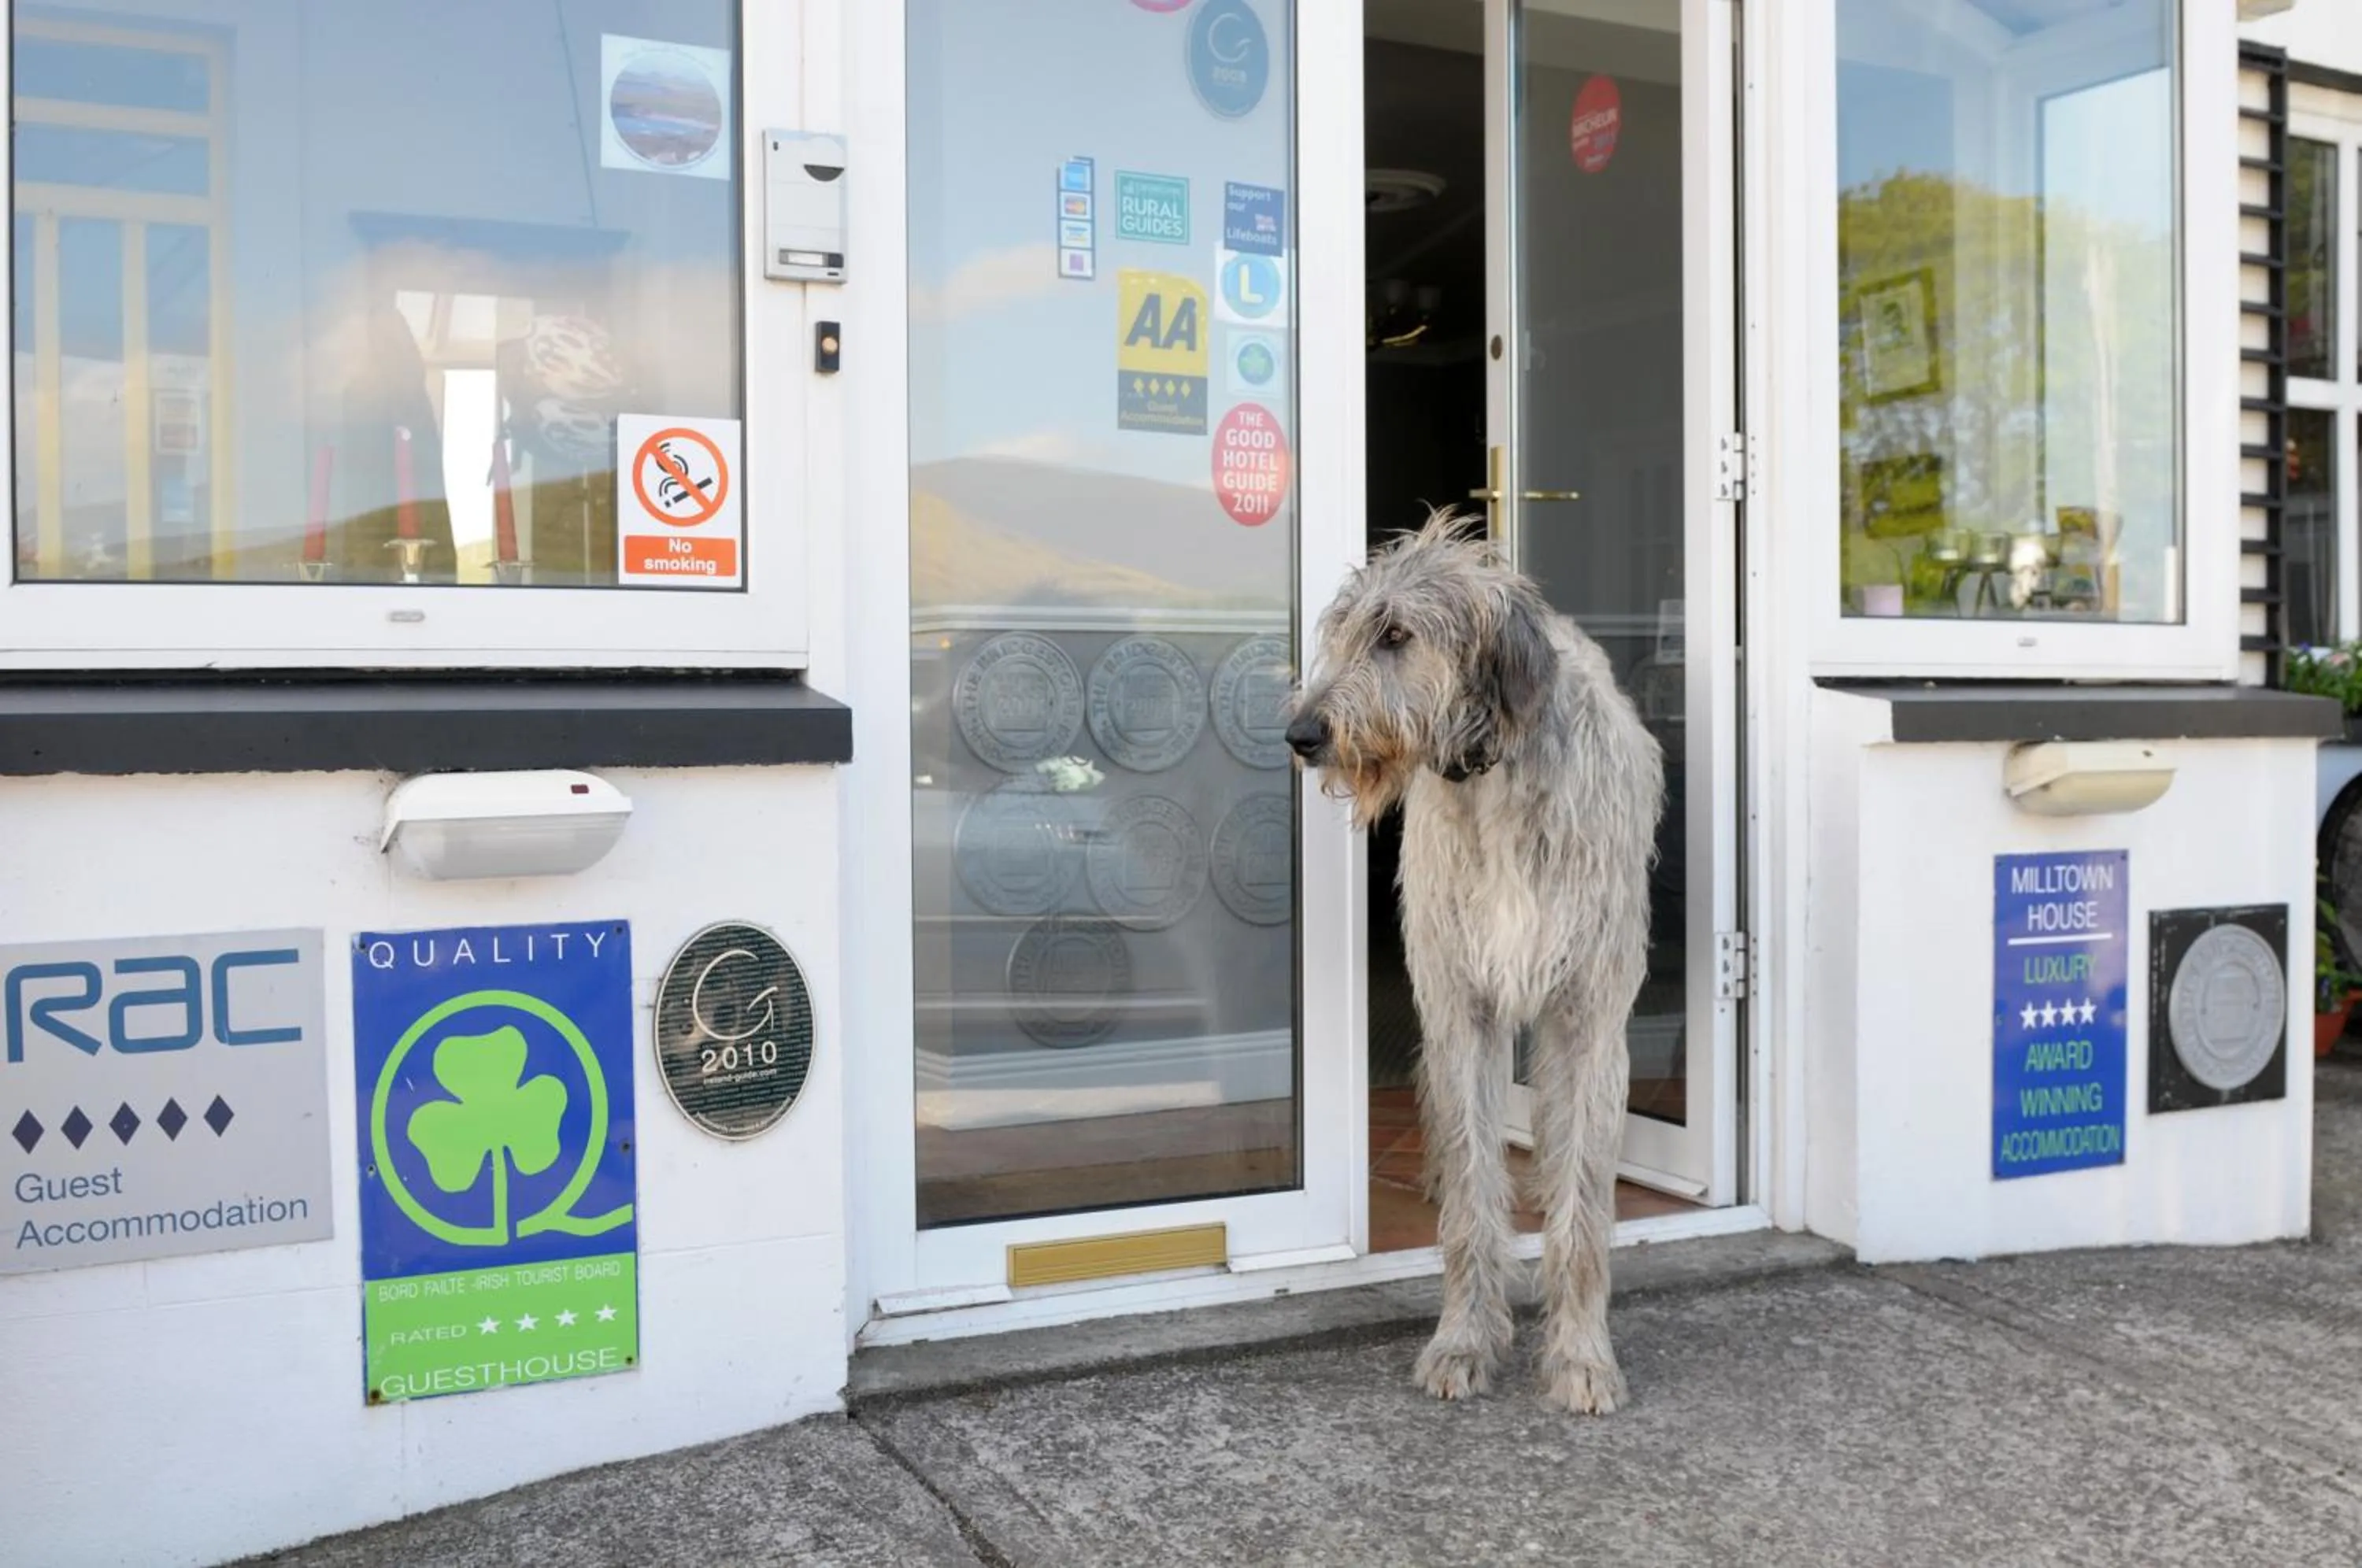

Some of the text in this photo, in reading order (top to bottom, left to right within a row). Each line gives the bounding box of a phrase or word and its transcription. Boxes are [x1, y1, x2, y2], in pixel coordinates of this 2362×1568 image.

[1228, 184, 1272, 202] Support
[1122, 196, 1183, 219] RURAL
[1227, 202, 1246, 213] our
[1122, 215, 1183, 236] GUIDES
[1227, 227, 1277, 246] Lifeboats
[1240, 264, 1264, 304] L
[1124, 293, 1197, 352] AA
[1238, 411, 1264, 427] THE
[1225, 429, 1275, 449] GOOD
[1223, 449, 1279, 471] HOTEL
[1222, 471, 1278, 492] GUIDE
[1233, 494, 1269, 514] 2011
[669, 538, 692, 554] No
[643, 555, 716, 575] smoking
[2012, 864, 2113, 893] MILLTOWN
[2028, 901, 2098, 931] HOUSE
[369, 931, 605, 969] QUALITY
[2024, 955, 2096, 984] LUXURY
[702, 1041, 777, 1073] 2010
[2025, 1041, 2093, 1071] AWARD
[2020, 1082, 2103, 1118] WINNING
[15, 1167, 123, 1203] Guest
[16, 1196, 308, 1248] Accommodation
[379, 1283, 418, 1302] BORD
[516, 1267, 568, 1286] TOURIST
[575, 1261, 621, 1278] BOARD
[391, 1325, 467, 1345] RATED
[380, 1347, 619, 1398] GUESTHOUSE
